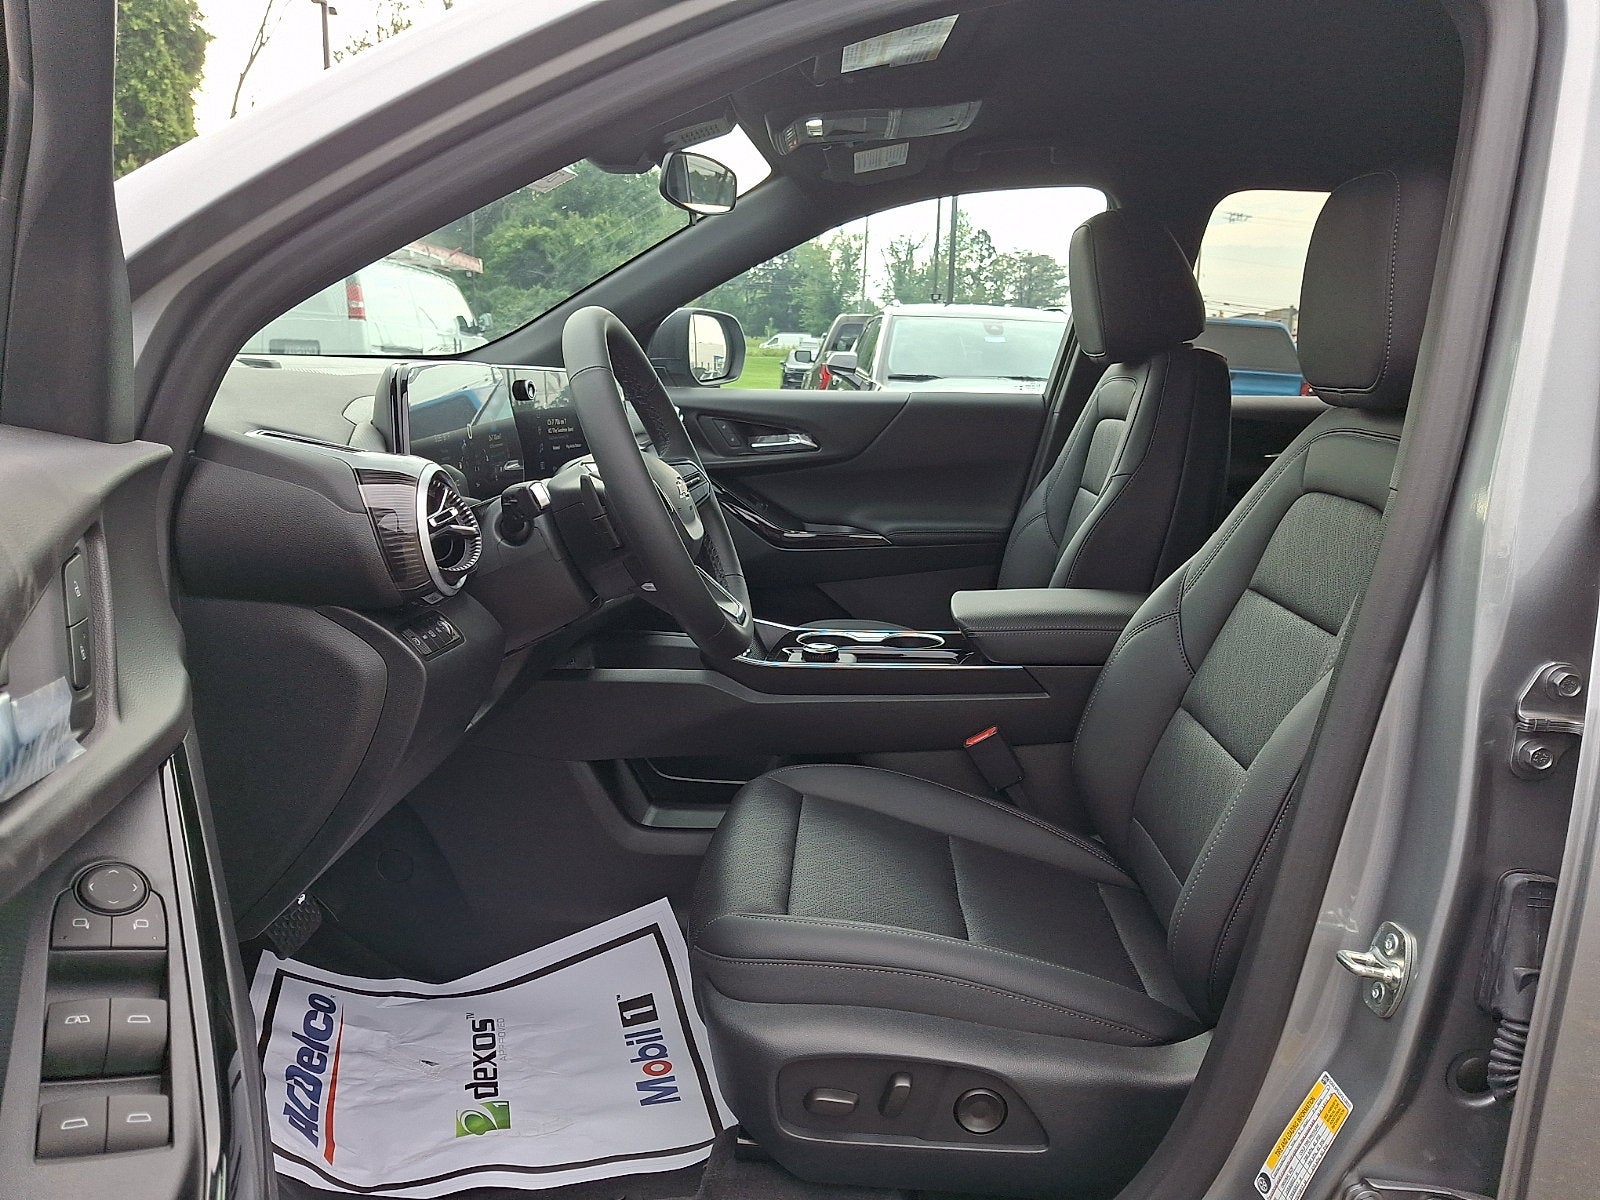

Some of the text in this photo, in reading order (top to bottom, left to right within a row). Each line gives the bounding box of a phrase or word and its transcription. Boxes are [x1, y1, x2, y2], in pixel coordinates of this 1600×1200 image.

[283, 993, 336, 1148] ACDelco
[465, 1019, 499, 1100] dexos
[624, 1027, 681, 1106] Mobil
